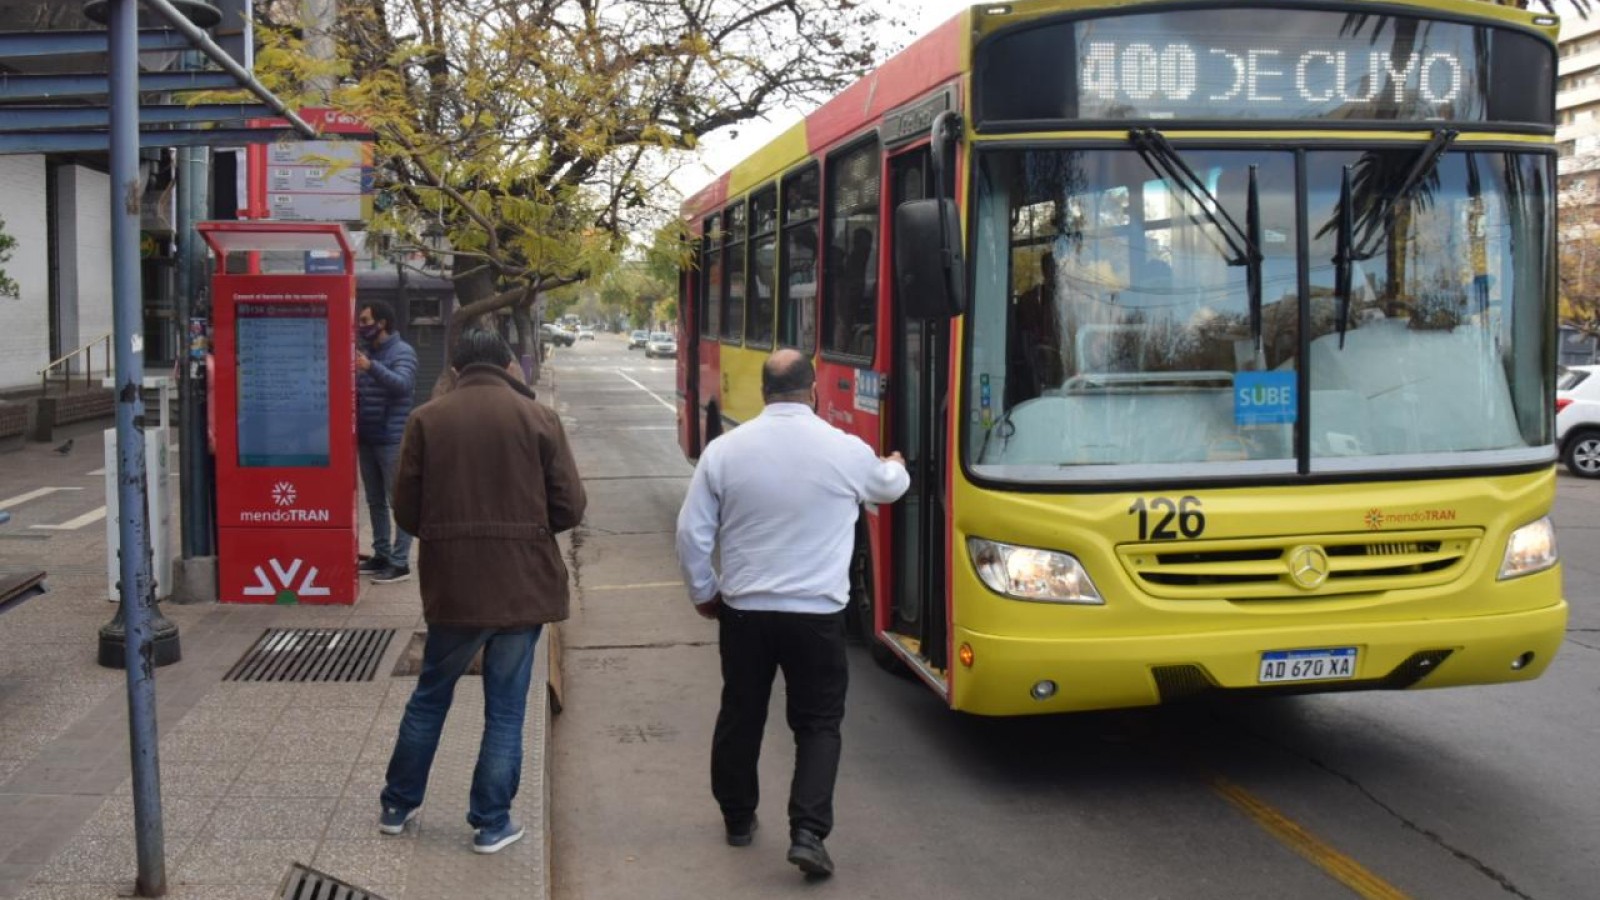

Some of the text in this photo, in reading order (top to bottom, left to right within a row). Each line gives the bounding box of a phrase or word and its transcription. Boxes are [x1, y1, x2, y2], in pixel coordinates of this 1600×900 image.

[1082, 42, 1197, 100] 400
[1295, 50, 1462, 103] CUYO
[1240, 385, 1291, 406] SUBE
[240, 509, 330, 521] mendoTRAN
[1127, 495, 1206, 541] 126
[1384, 509, 1456, 524] mendoTRAN
[1264, 658, 1349, 679] AD 670 XA
